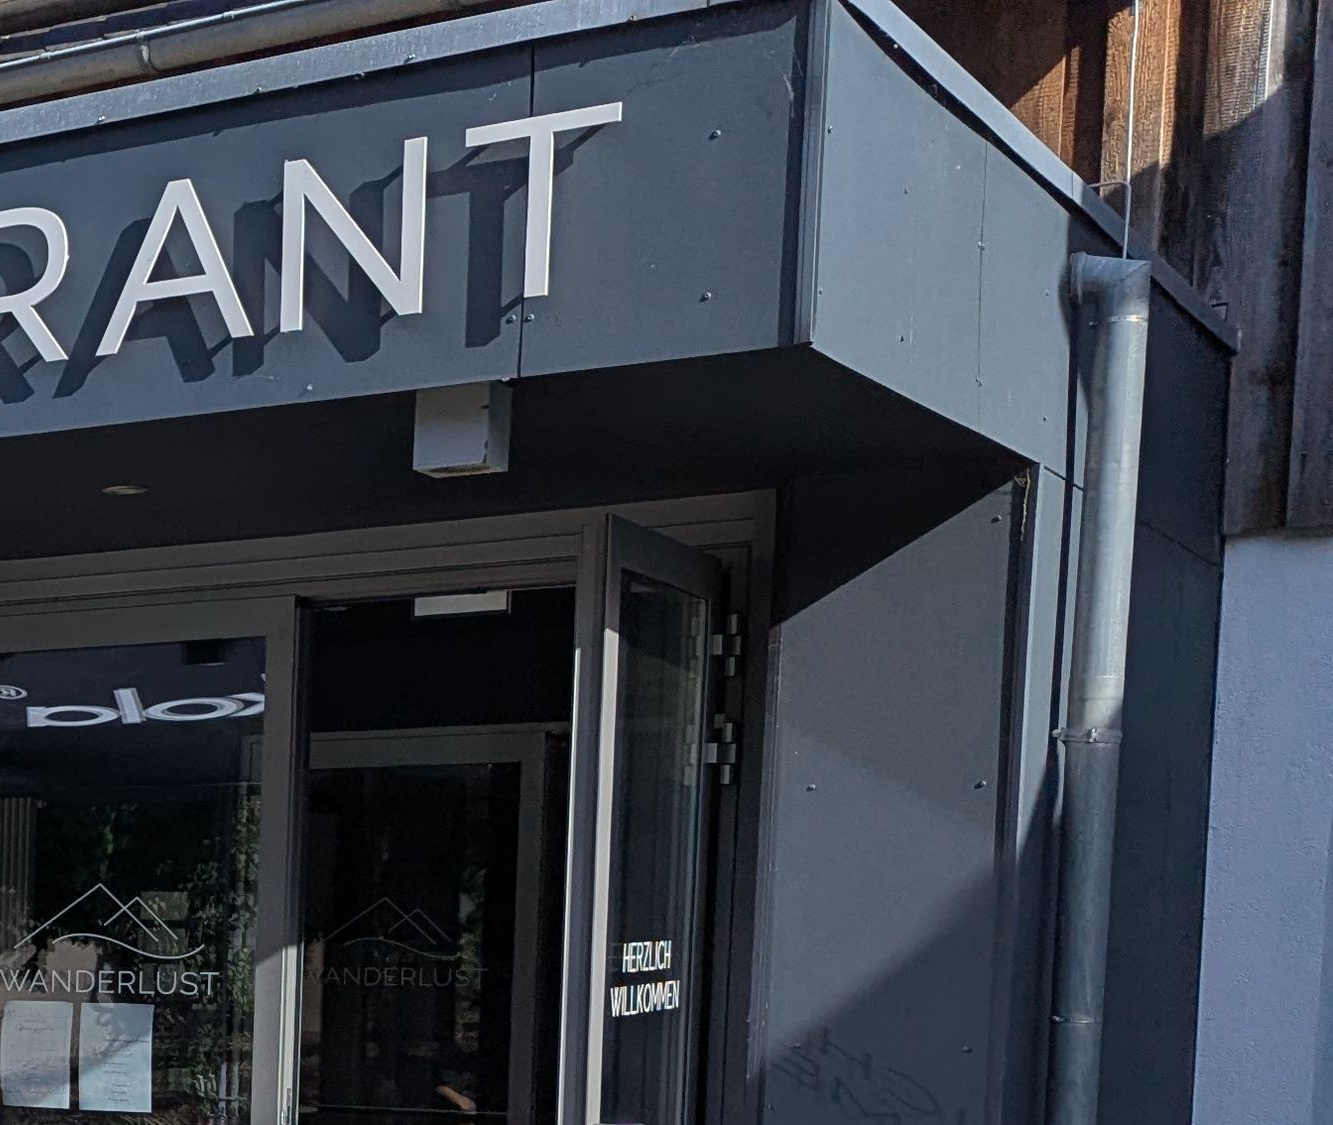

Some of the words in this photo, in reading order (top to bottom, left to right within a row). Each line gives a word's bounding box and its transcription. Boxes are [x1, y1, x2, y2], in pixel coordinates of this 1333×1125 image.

[622, 940, 672, 973] HERZLICH
[0, 968, 220, 996] WANDERLUST
[610, 980, 680, 1017] WILLKOMMEN
